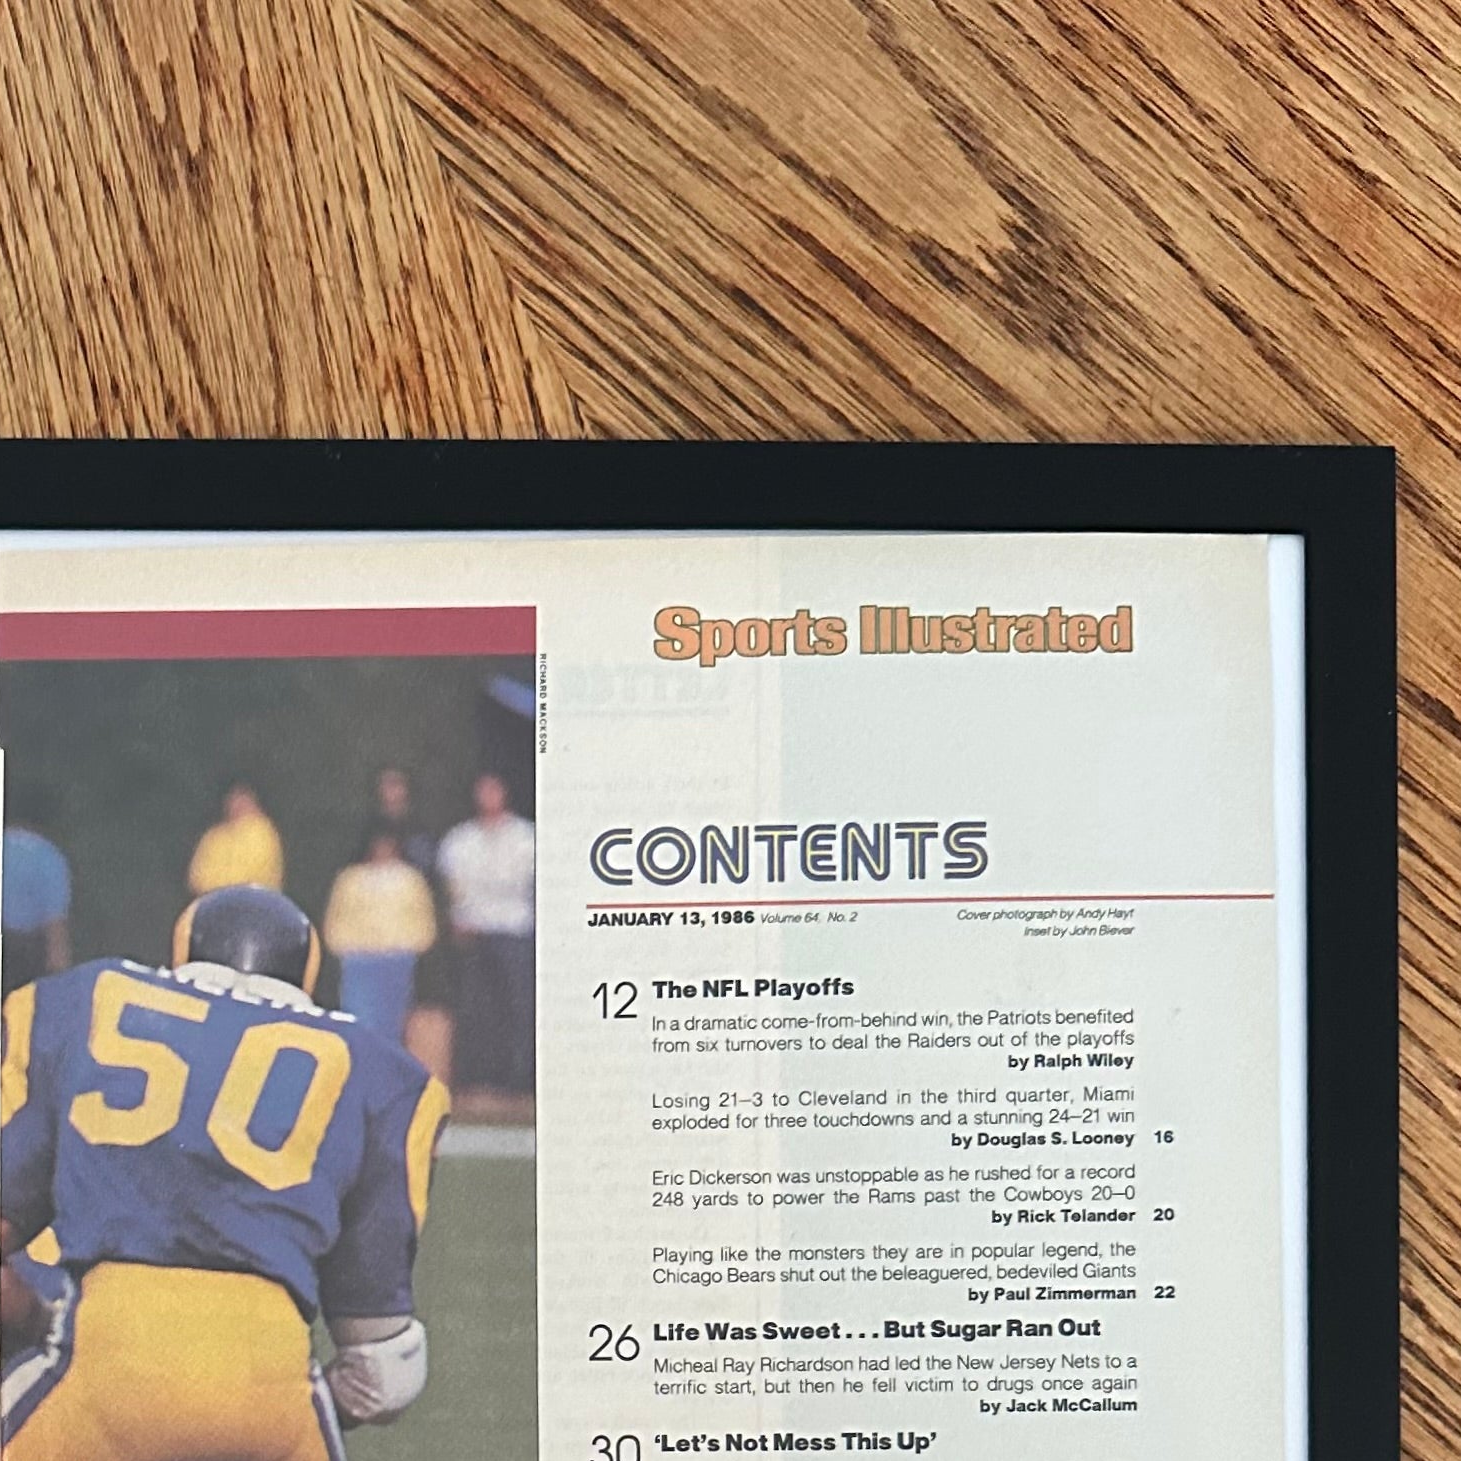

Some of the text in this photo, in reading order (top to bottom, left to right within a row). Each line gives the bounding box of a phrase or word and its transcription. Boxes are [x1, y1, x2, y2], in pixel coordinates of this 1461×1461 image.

[653, 605, 1133, 667] Sports Illustrated
[538, 653, 547, 754] RICHARD MACKSON
[589, 821, 989, 886] CONTENTS
[587, 909, 755, 928] JANUARY 13, 1986
[760, 912, 802, 924] Volume
[848, 911, 858, 922] 2
[956, 907, 1135, 922] Cover photograph by Andy Hayt
[1023, 923, 1135, 939] Inset by John Biever
[651, 976, 854, 1001] The NFL Playoffs
[592, 980, 638, 1019] 12
[1007, 1052, 1135, 1071] by Ralph Wiley
[69, 968, 351, 1191] 50
[652, 1085, 1134, 1111] Losing 21–3 to Cleveland in the third quarter, Miami
[951, 1130, 1136, 1150] by Douglas S. Looney
[1153, 1129, 1174, 1144] 16
[651, 1184, 1135, 1210] 248 yards to power the Rams past the Cowboys 20–0
[991, 1208, 1137, 1227] by Rick Telander
[1152, 1207, 1175, 1221] 20
[967, 1285, 1137, 1305] by Paul Zimmerman
[1153, 1285, 1176, 1299] 22
[588, 1323, 640, 1361] 26
[979, 1397, 1138, 1416] by Jack McCallum
[654, 1431, 937, 1455] ‘Let’s Not Mess This Up’
